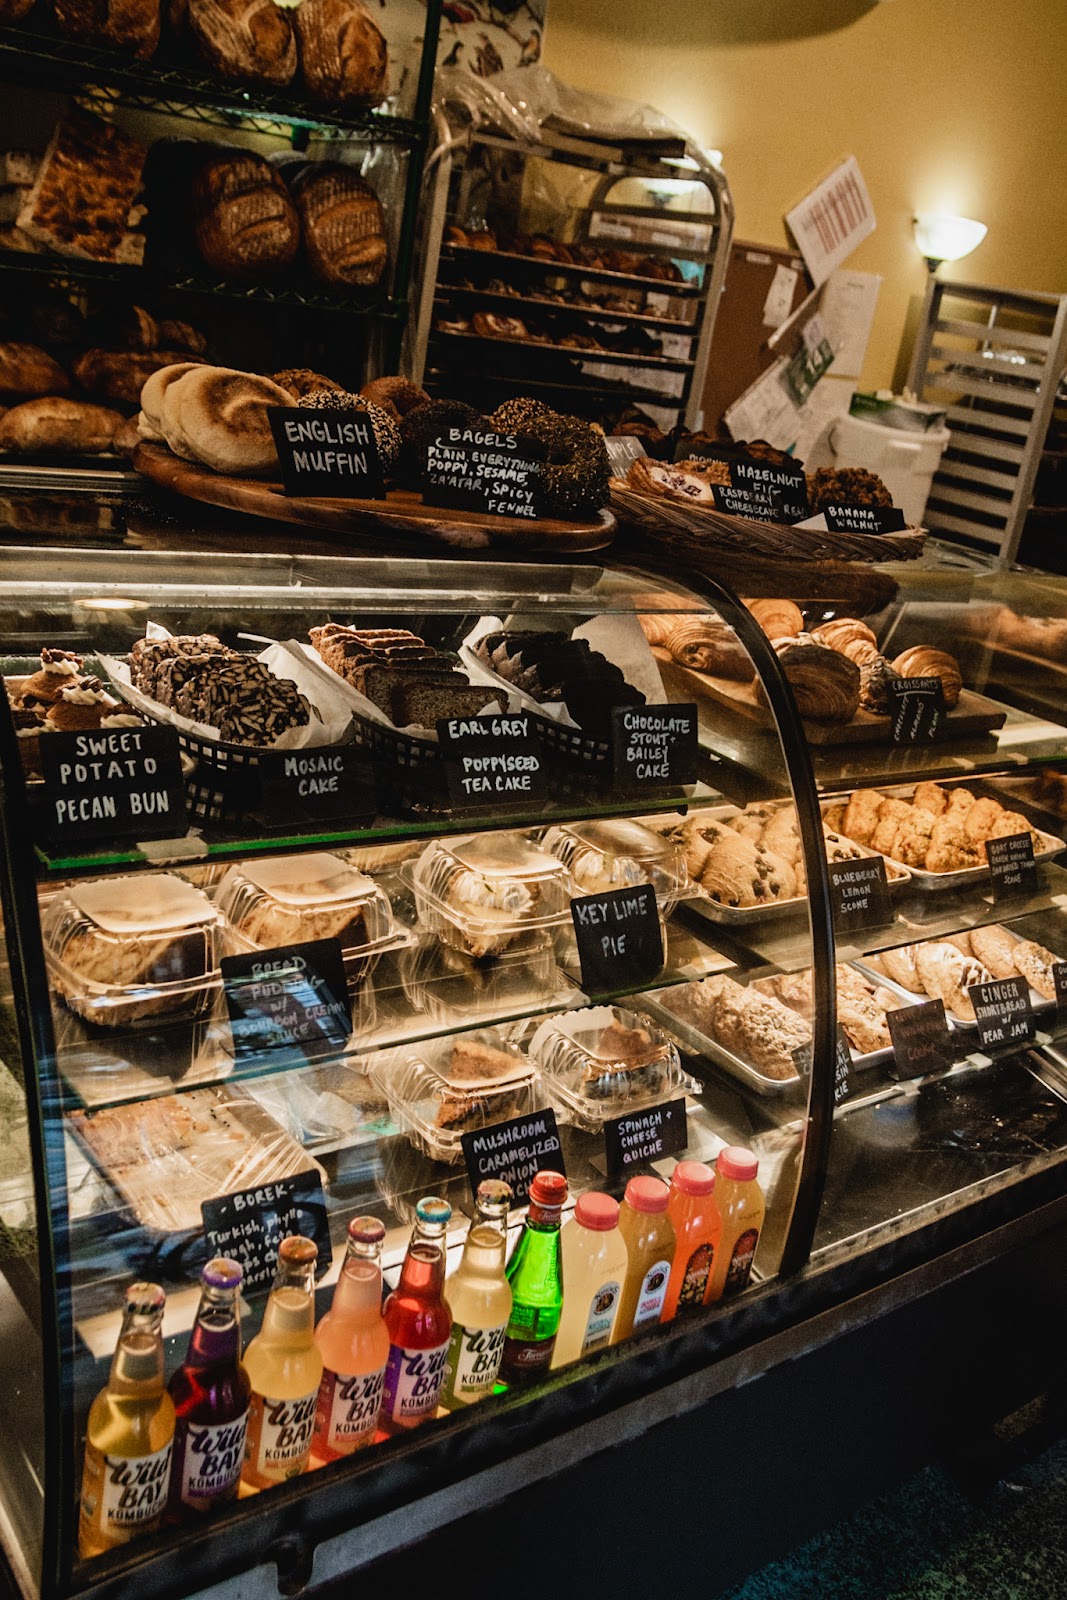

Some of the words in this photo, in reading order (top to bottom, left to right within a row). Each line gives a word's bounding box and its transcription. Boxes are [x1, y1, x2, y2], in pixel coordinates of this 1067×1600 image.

[284, 420, 370, 445] ENGLISH
[449, 428, 518, 449] BAGELS
[292, 449, 368, 475] MUFFIN
[471, 452, 541, 474] EVERYTHING
[737, 464, 803, 488] HAZELNUT
[718, 486, 773, 506] RASPBERRY
[753, 482, 781, 494] FIG
[488, 499, 536, 517] FENNEL
[725, 498, 779, 518] CHEESECAKE
[828, 505, 875, 519] BANANA
[836, 519, 882, 531] WALNUT
[892, 679, 939, 690] CROISSANTS
[448, 720, 489, 739] EARL
[491, 718, 528, 737] GREY
[624, 713, 690, 734] CHOCOLATE
[76, 732, 142, 757] SWEET
[630, 732, 668, 746] STOUT
[462, 754, 540, 773] POPPYSEED
[626, 745, 669, 764] BAILEY
[60, 757, 158, 785] POTATO
[284, 755, 344, 777] MOSAIC
[636, 762, 670, 779] CAKE
[298, 776, 339, 796] CAKE
[461, 777, 491, 794] TEA
[495, 775, 531, 791] CAKE
[56, 796, 117, 824] PECAN
[131, 790, 170, 815] BUN
[832, 866, 881, 886] BLUEBERRY
[842, 884, 872, 898] LEMON
[576, 902, 608, 925] KEY
[613, 894, 648, 920] LIME
[840, 898, 869, 914] SCONE
[601, 934, 626, 957] PIE
[251, 956, 307, 976] BREAD
[981, 982, 1019, 1003] GINGER
[305, 1001, 346, 1020] CREAM
[976, 999, 1027, 1019] SHORTBREAD
[983, 1028, 1005, 1044] PEAR
[1010, 1021, 1029, 1037] JAM
[618, 1112, 662, 1136] SPINACH
[472, 1120, 546, 1153] MUSHROOM
[621, 1129, 658, 1149] CHEESE
[478, 1136, 560, 1173] CARAMELIZED
[623, 1138, 663, 1164] QUICHE
[500, 1159, 538, 1183] ONION
[267, 1207, 303, 1233] phyllo
[104, 1446, 171, 1486] Wild
